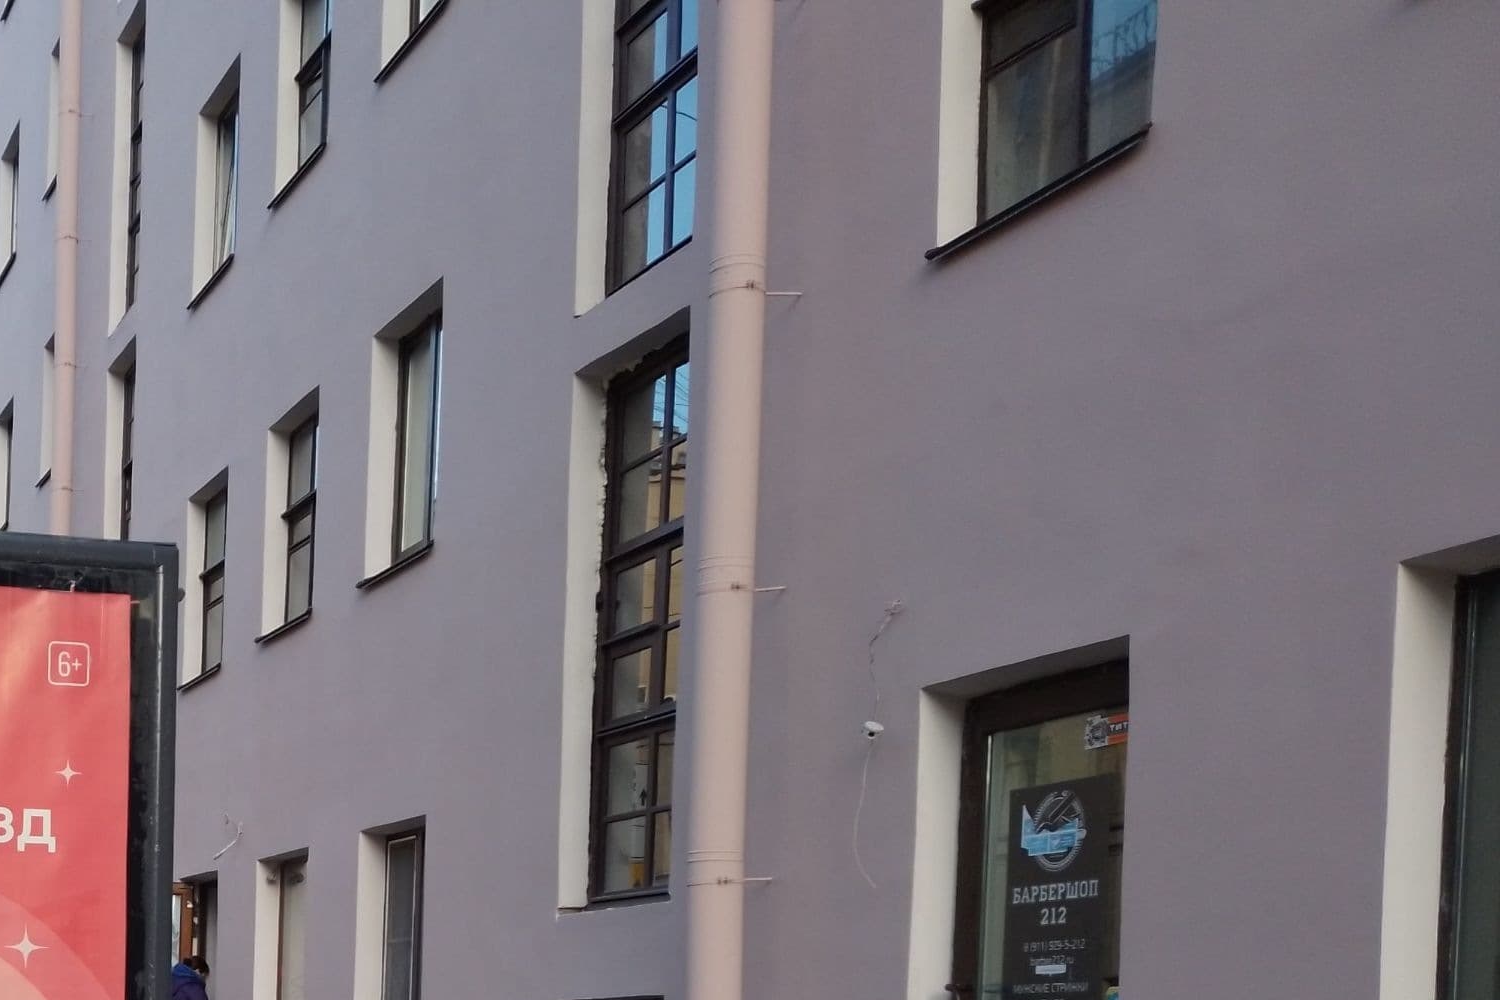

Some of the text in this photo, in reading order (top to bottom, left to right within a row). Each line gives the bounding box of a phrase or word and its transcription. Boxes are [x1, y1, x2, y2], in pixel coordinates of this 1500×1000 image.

[56, 650, 84, 679] 6+
[1012, 879, 1099, 904] БАРБЕРШОП
[1040, 906, 1067, 925] 212
